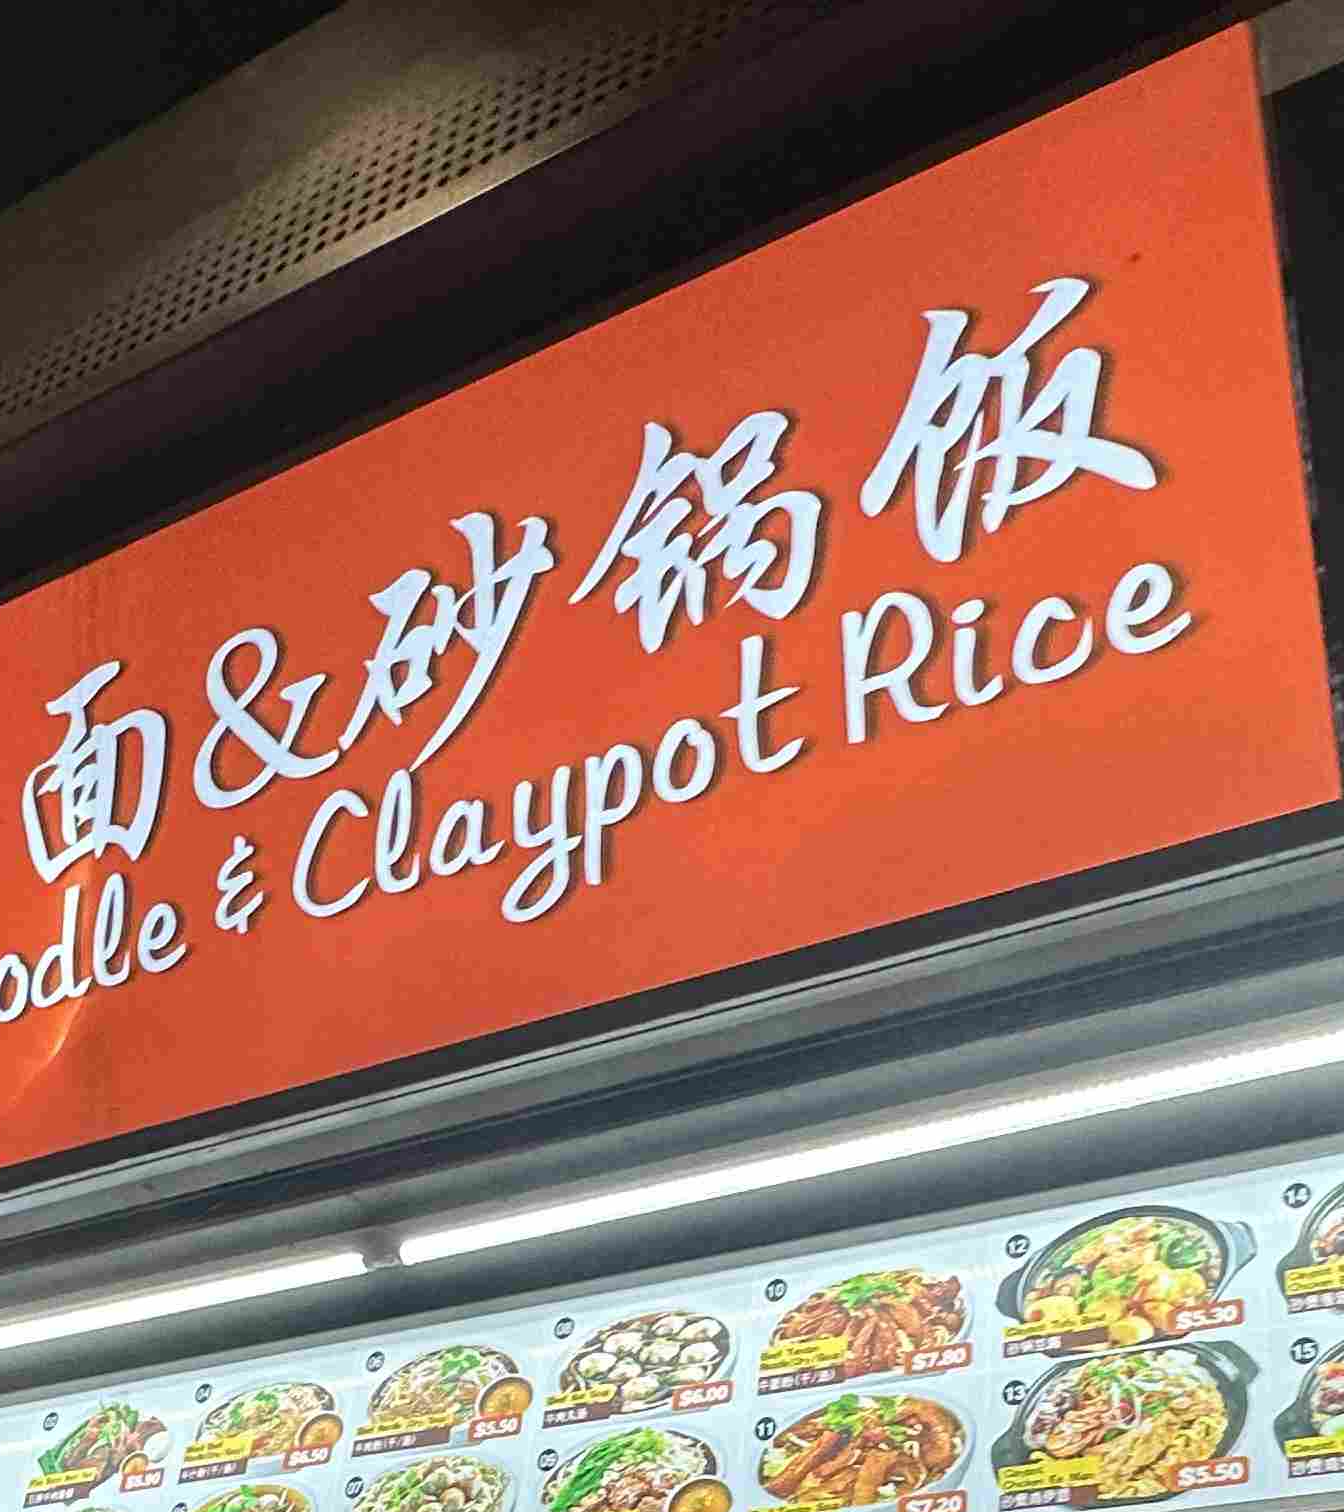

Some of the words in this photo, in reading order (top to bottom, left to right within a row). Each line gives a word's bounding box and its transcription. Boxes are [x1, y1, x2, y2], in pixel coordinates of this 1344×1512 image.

[215, 835, 264, 934] &
[292, 635, 805, 922] Claypot
[842, 562, 1192, 744] Rice
[1177, 1305, 1239, 1331] $5.30
[677, 1385, 729, 1406] $6.00
[1177, 1464, 1244, 1490] $5.50
